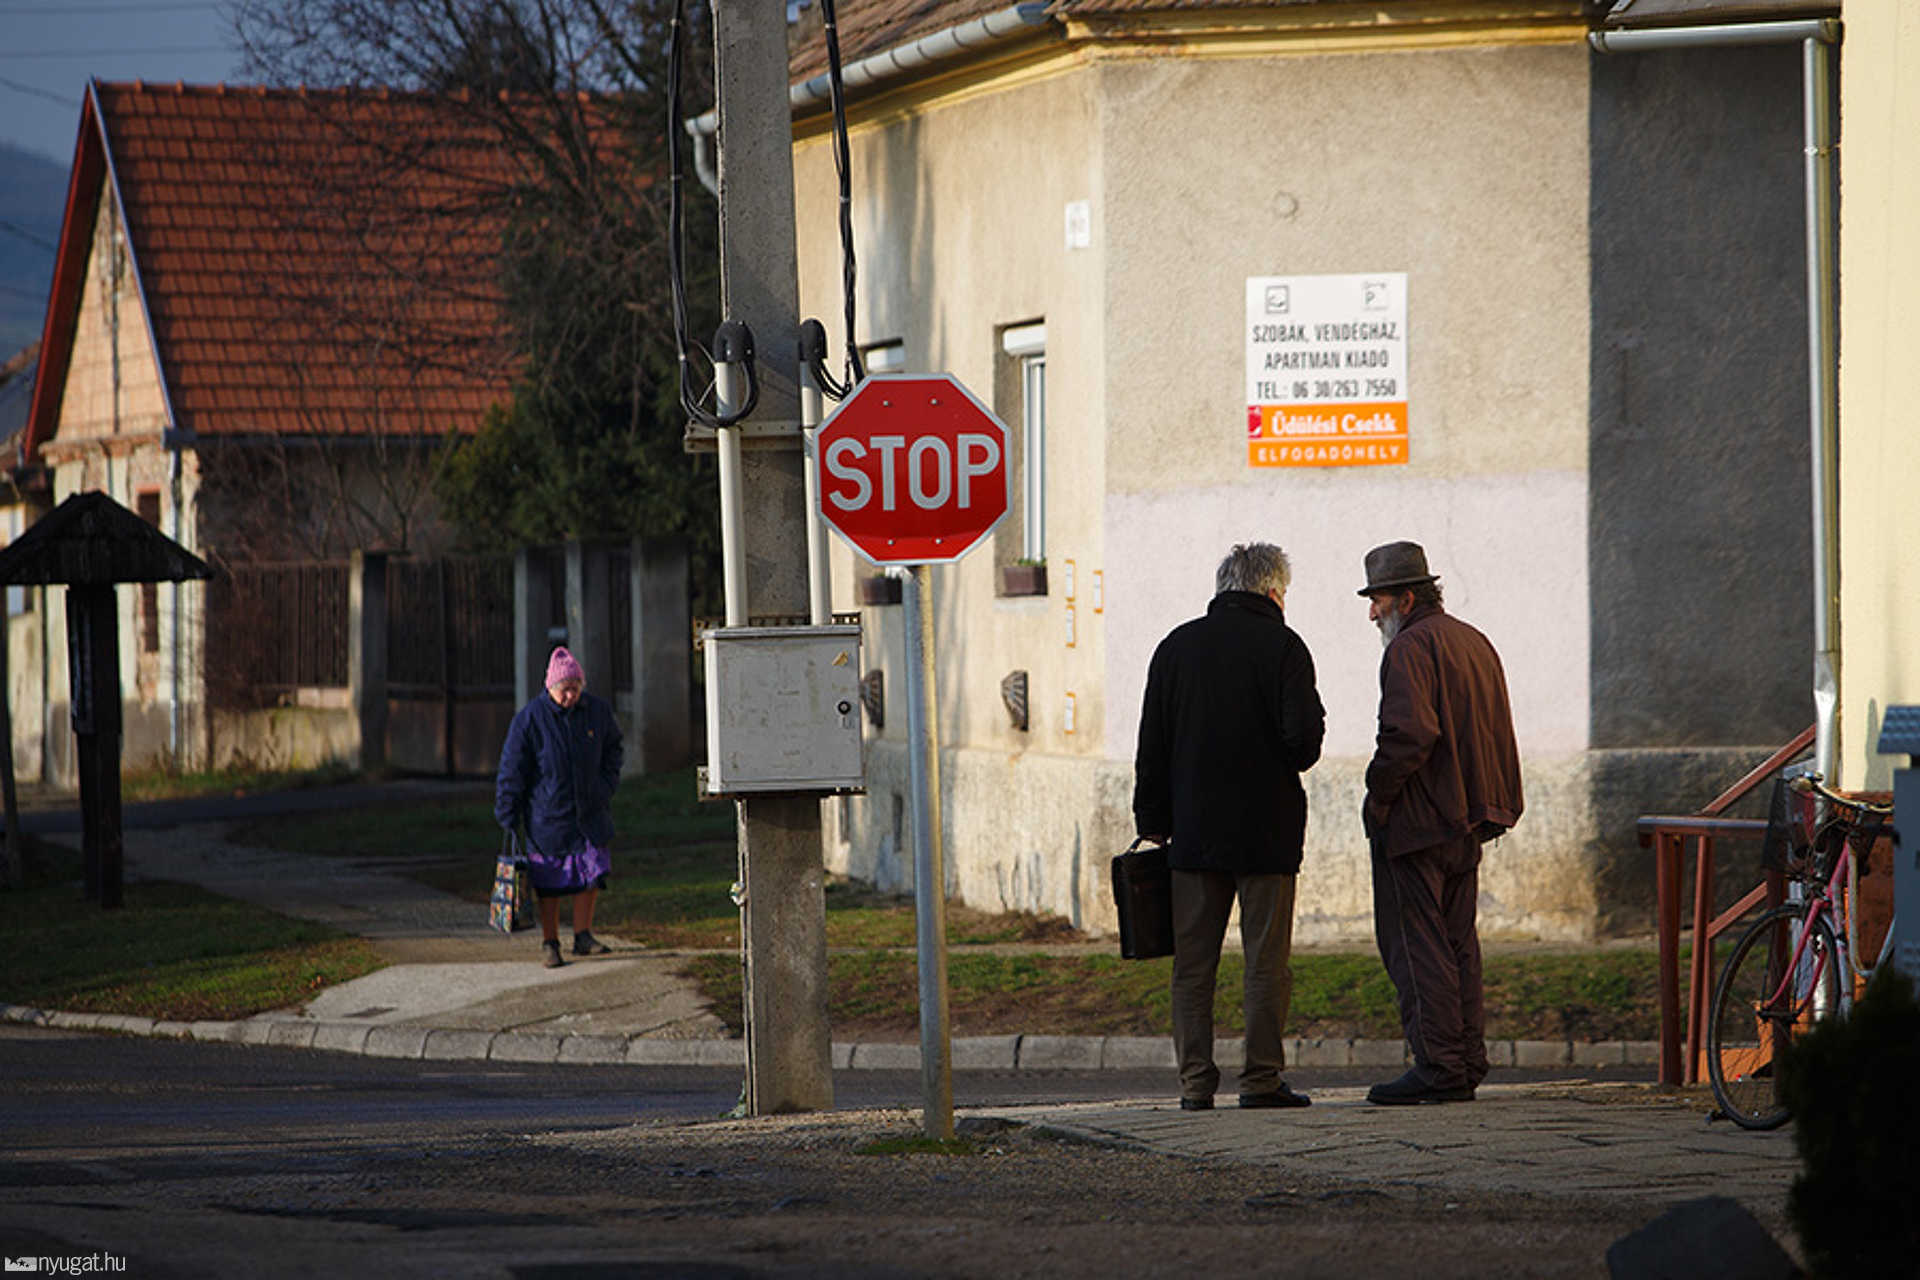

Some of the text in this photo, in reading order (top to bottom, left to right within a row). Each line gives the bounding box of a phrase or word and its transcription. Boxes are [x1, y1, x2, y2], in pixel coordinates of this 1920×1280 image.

[1264, 351, 1341, 370] APARTMAN
[1293, 381, 1309, 399] 06
[1365, 379, 1396, 397] 7550
[1341, 412, 1397, 434] Csekk
[825, 433, 1000, 511] STOP
